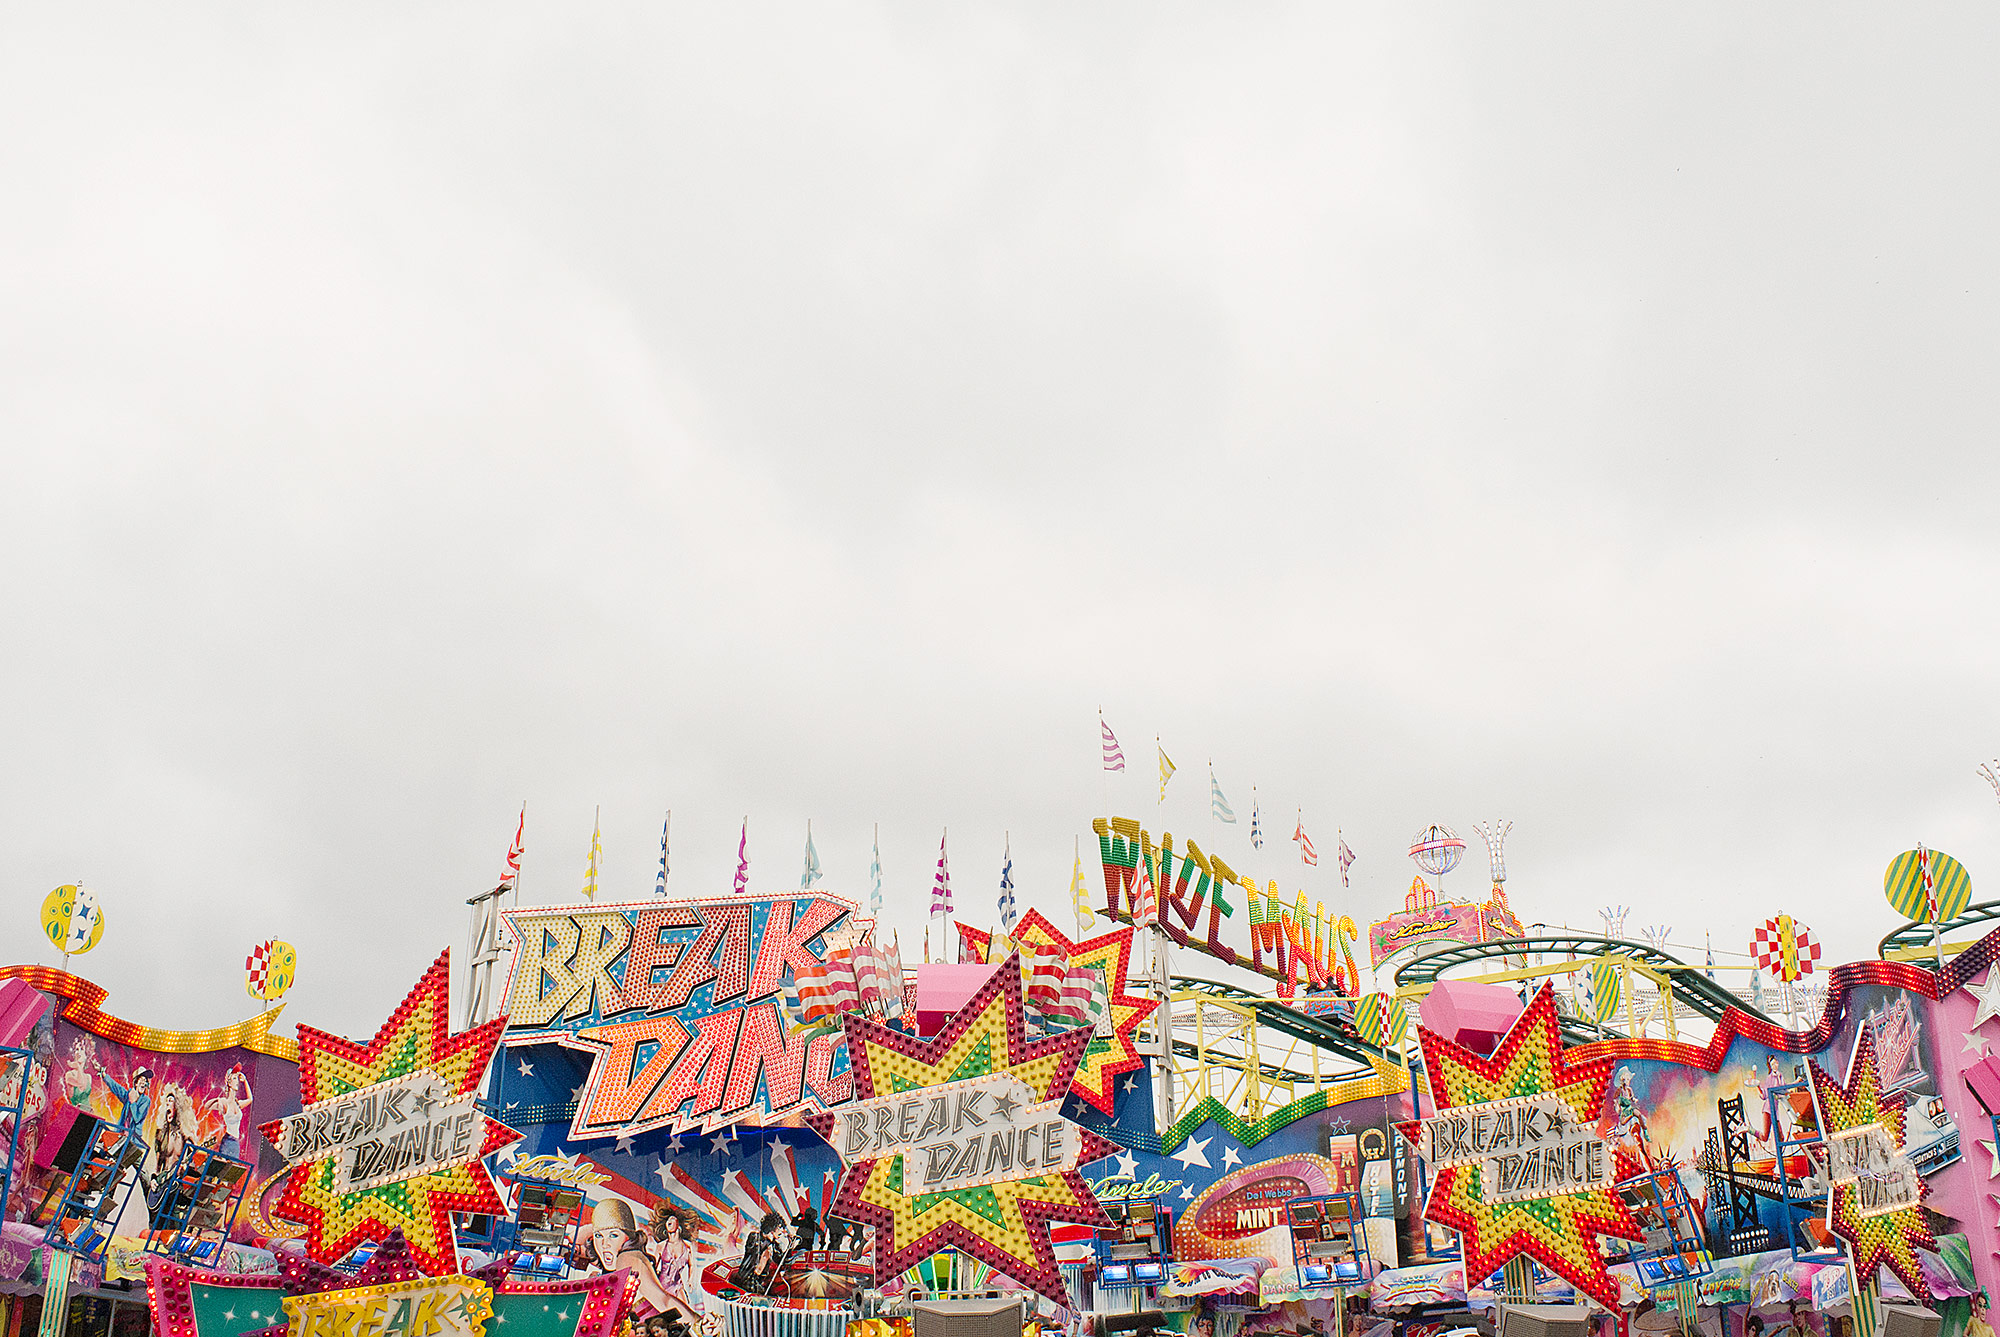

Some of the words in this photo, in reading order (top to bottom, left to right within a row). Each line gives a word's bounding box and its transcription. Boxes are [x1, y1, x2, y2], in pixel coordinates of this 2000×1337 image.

[1092, 816, 1240, 965] WILDE
[1241, 875, 1361, 1007] MAUS
[508, 898, 852, 1028] BREAK
[577, 1003, 856, 1126] DANC
[287, 1087, 412, 1159] BREAK
[348, 1110, 477, 1184] DANCE
[841, 1088, 988, 1156] BREAK
[1426, 1105, 1544, 1163] BREAK
[503, 1152, 613, 1185] Kinzler
[916, 1119, 1066, 1186] DANCE
[1488, 1139, 1604, 1194] DANCE
[1236, 1206, 1283, 1230] MINT
[1246, 1190, 1263, 1201] Del
[1265, 1188, 1292, 1199] Webbs
[1370, 1165, 1381, 1217] HOTEL
[1261, 1283, 1300, 1296] DANCE
[1655, 1289, 1676, 1302] MUSI
[1702, 1277, 1743, 1296] LOVERS
